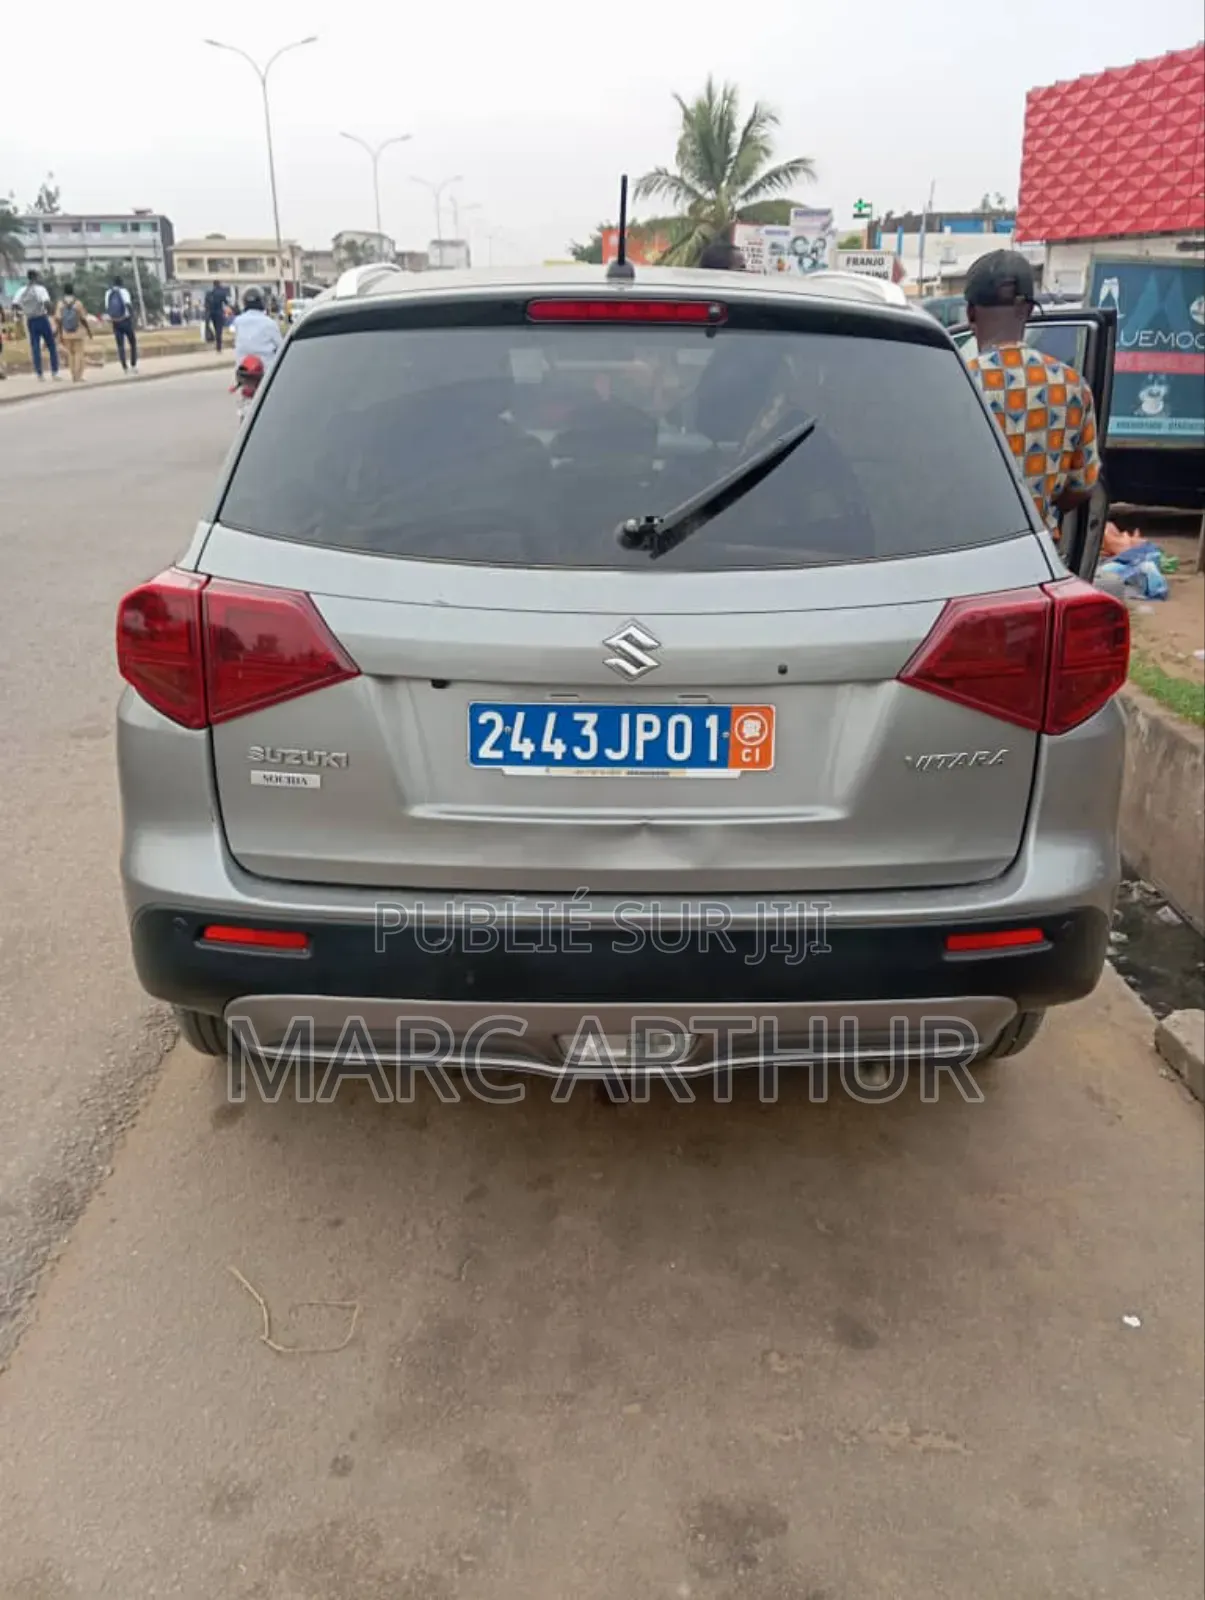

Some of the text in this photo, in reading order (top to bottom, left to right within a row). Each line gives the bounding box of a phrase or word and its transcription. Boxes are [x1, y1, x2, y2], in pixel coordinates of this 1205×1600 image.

[846, 257, 885, 266] FRANJO
[248, 745, 349, 768] SUZUKI
[904, 749, 1009, 770] VITARA
